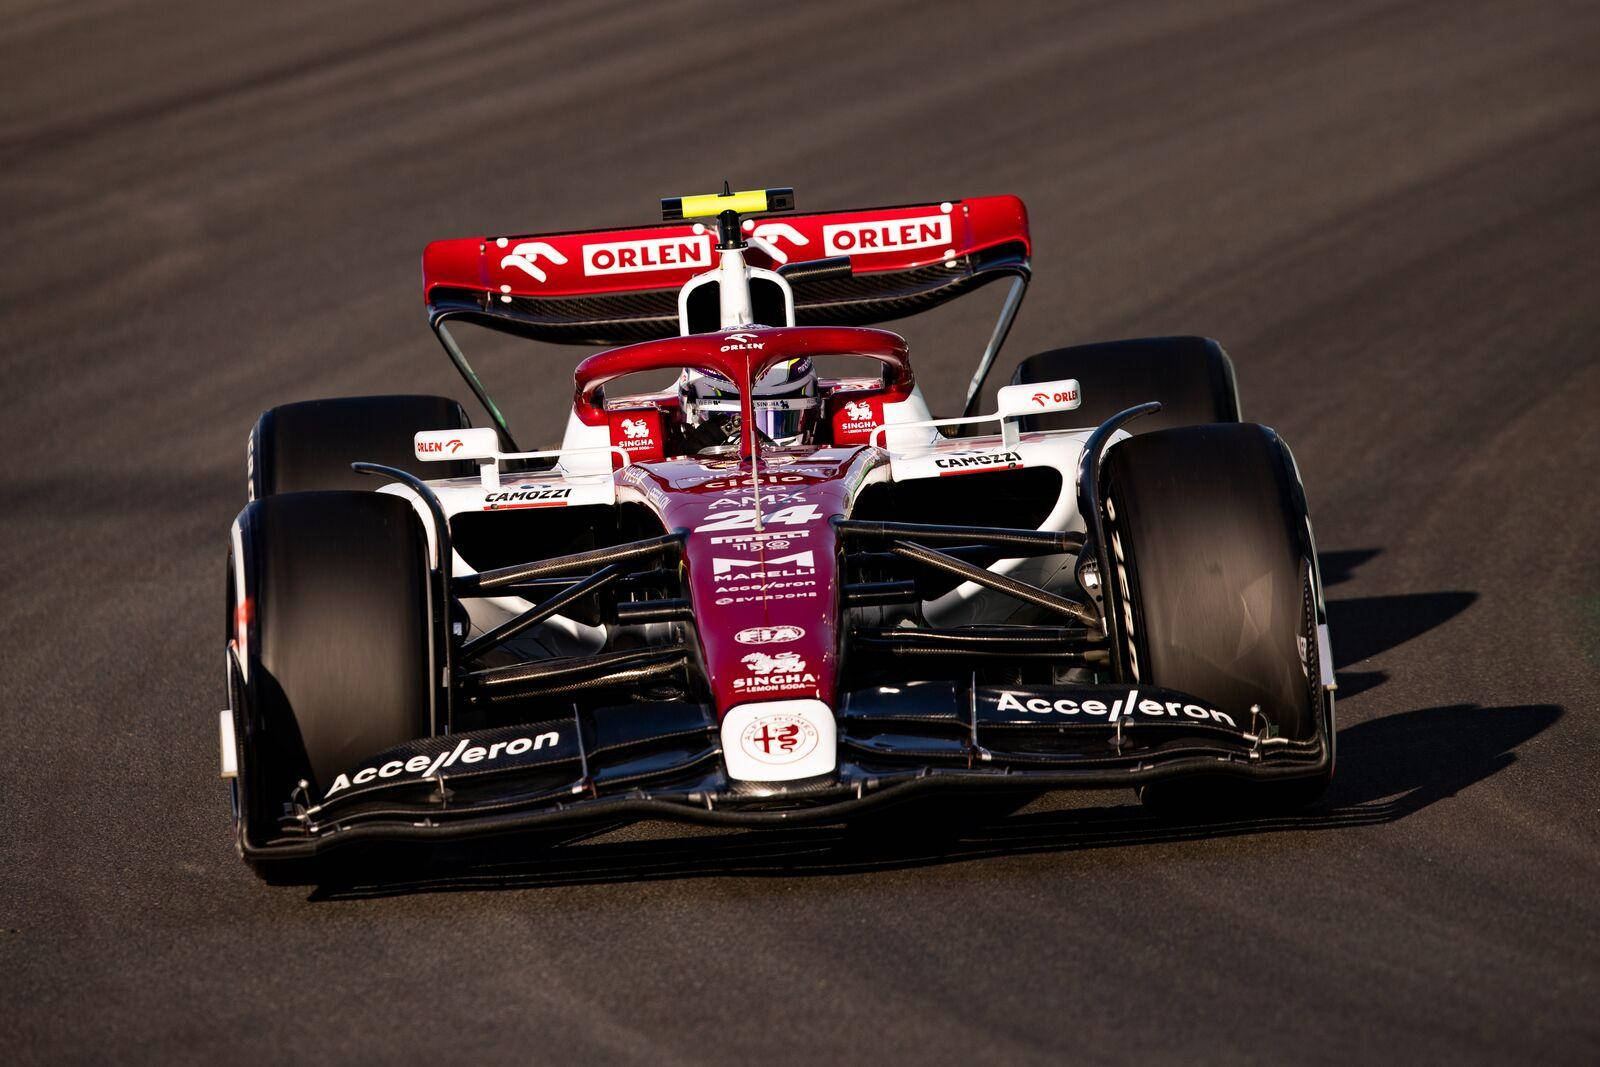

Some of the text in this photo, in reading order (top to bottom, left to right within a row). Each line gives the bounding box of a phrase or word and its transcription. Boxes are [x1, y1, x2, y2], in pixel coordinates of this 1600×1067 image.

[832, 221, 943, 250] ORLEN
[591, 241, 702, 268] ORLEN
[720, 342, 766, 353] ORLEN
[841, 421, 877, 430] SINGHA
[618, 438, 654, 448] SINGHA
[934, 451, 1023, 468] CAMOZZI
[484, 488, 573, 503] CAMOZZI
[708, 491, 807, 507] AMX
[693, 503, 824, 534] 24
[713, 567, 816, 582] MARELLI
[738, 626, 799, 643] FIA
[732, 673, 817, 689] SINGHA
[746, 683, 806, 693] LEMON SODA
[996, 689, 1238, 728] Accelleron
[323, 731, 560, 800] Accelleron
